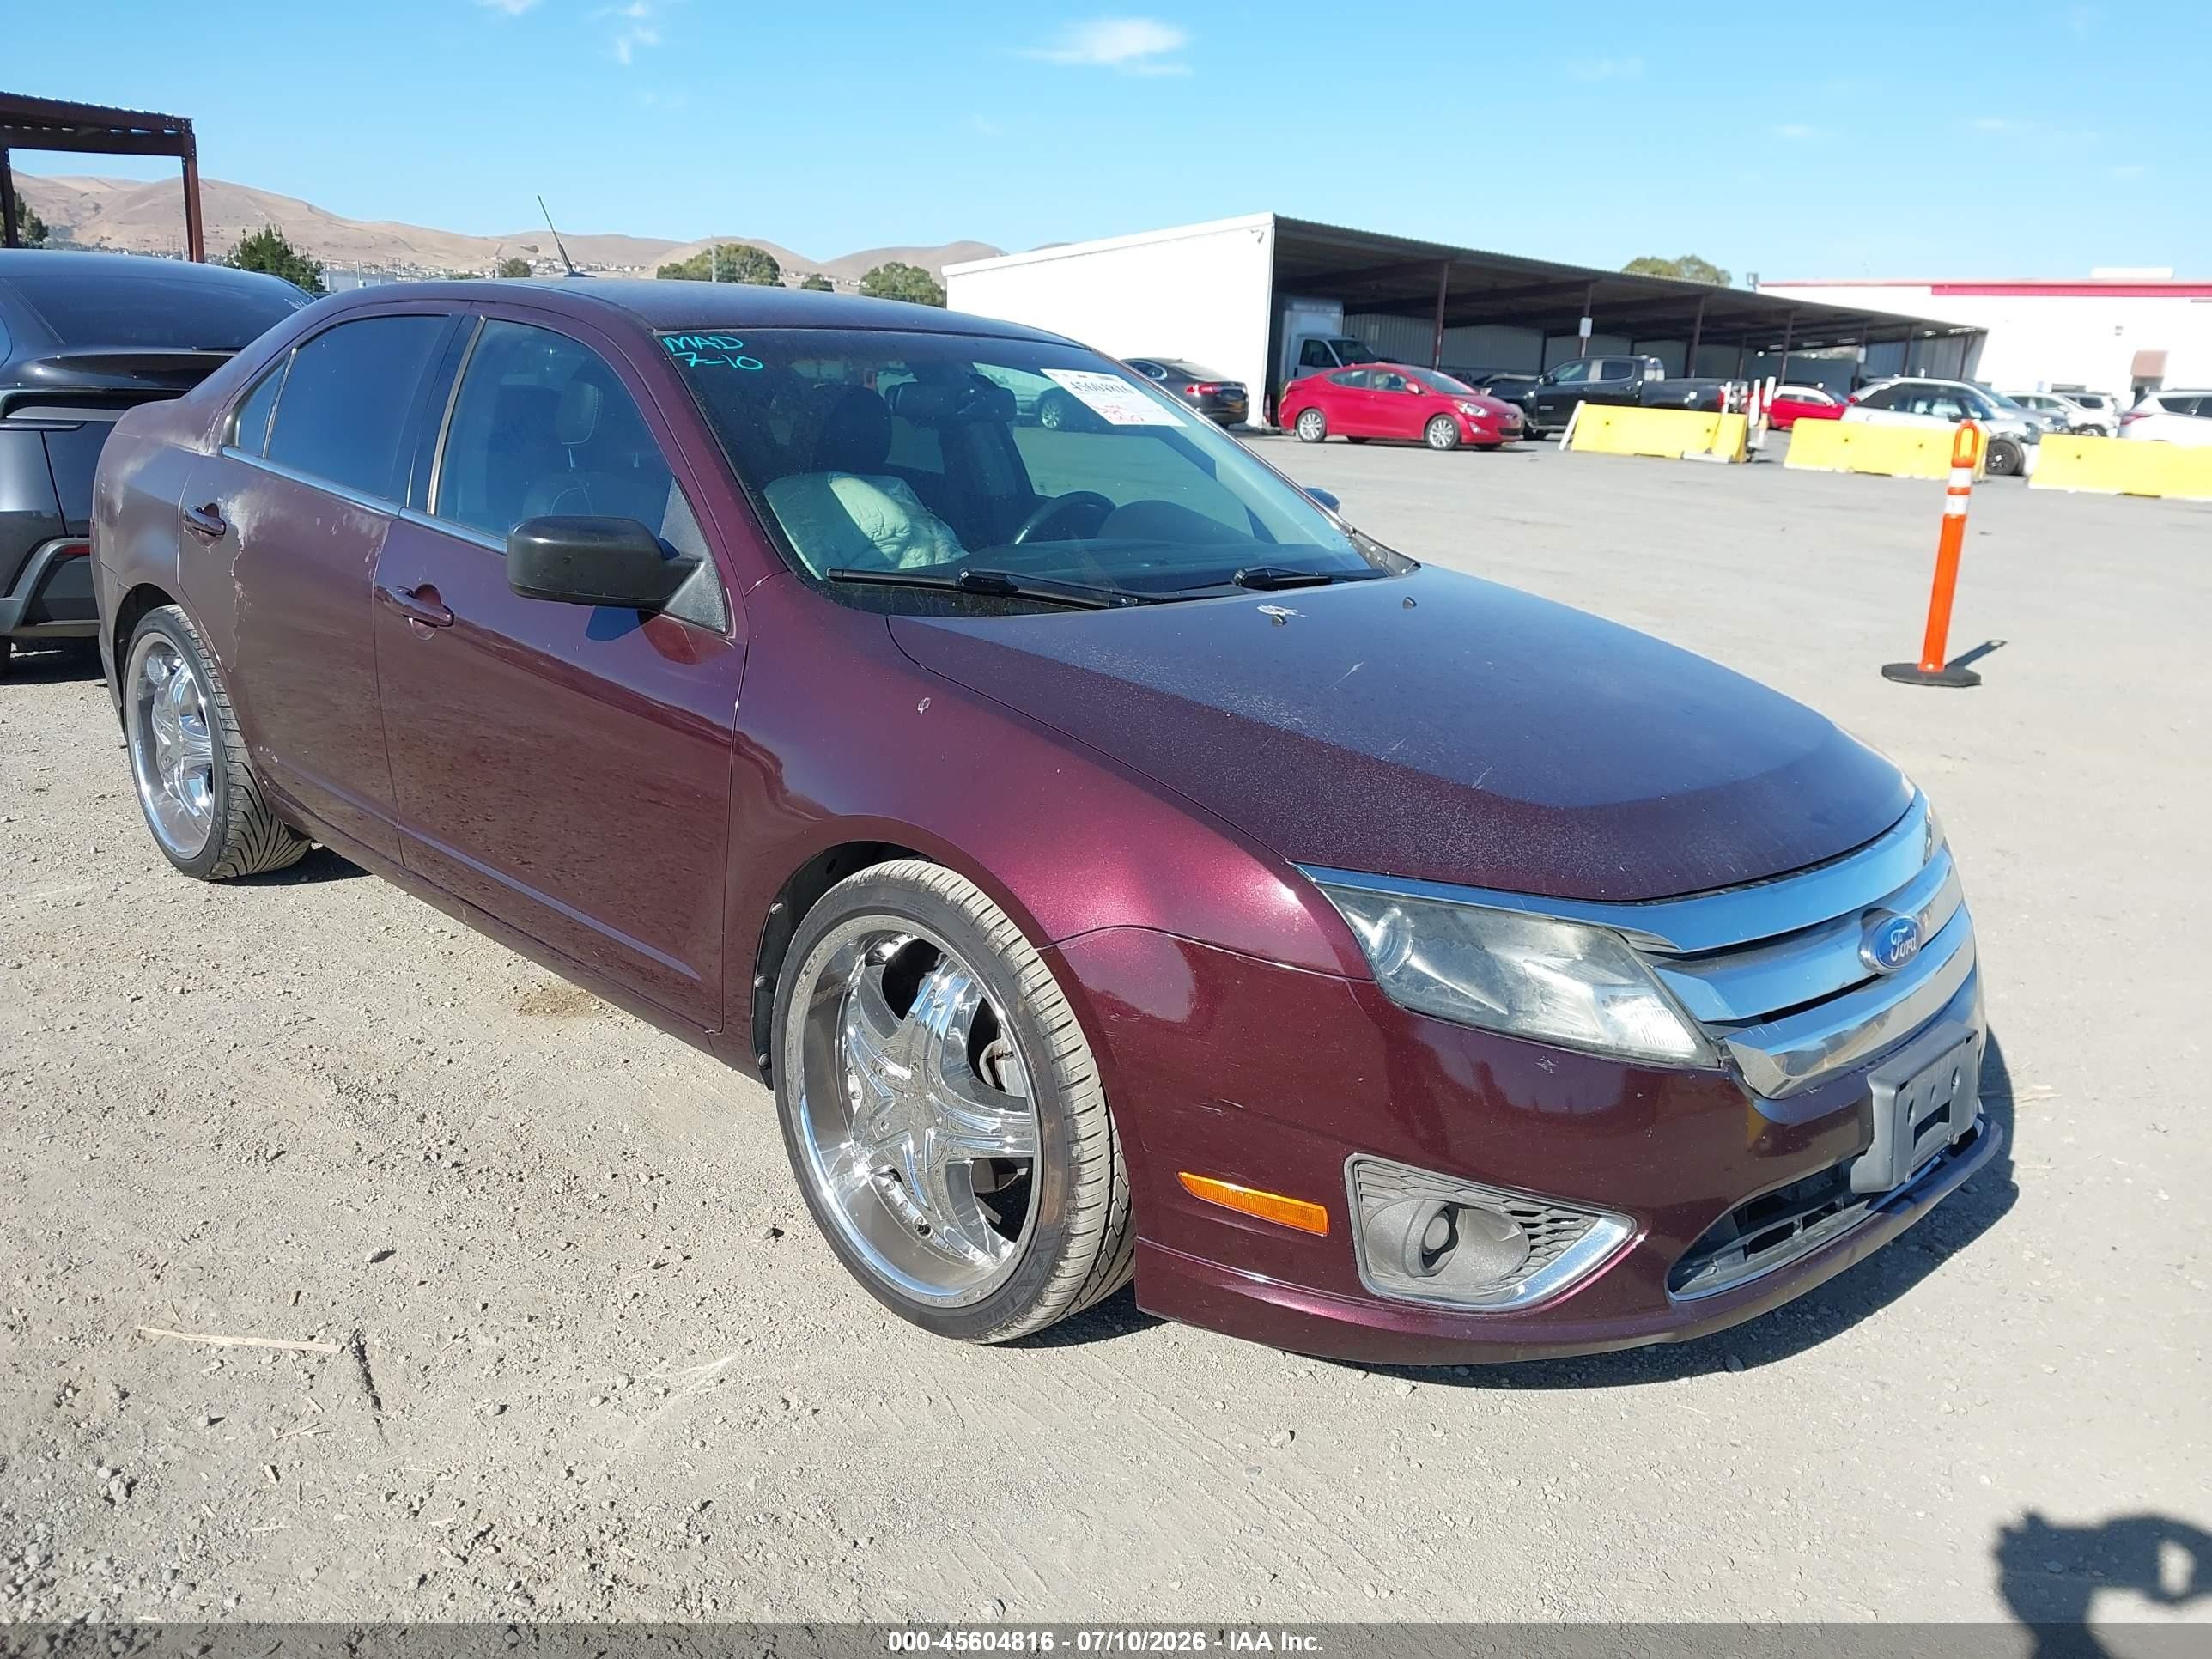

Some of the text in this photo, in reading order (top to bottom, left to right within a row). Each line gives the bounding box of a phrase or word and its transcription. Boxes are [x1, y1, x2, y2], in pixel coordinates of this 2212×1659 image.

[663, 336, 744, 353] MAD
[672, 351, 763, 370] 7-10
[1890, 926, 1917, 962] Ford
